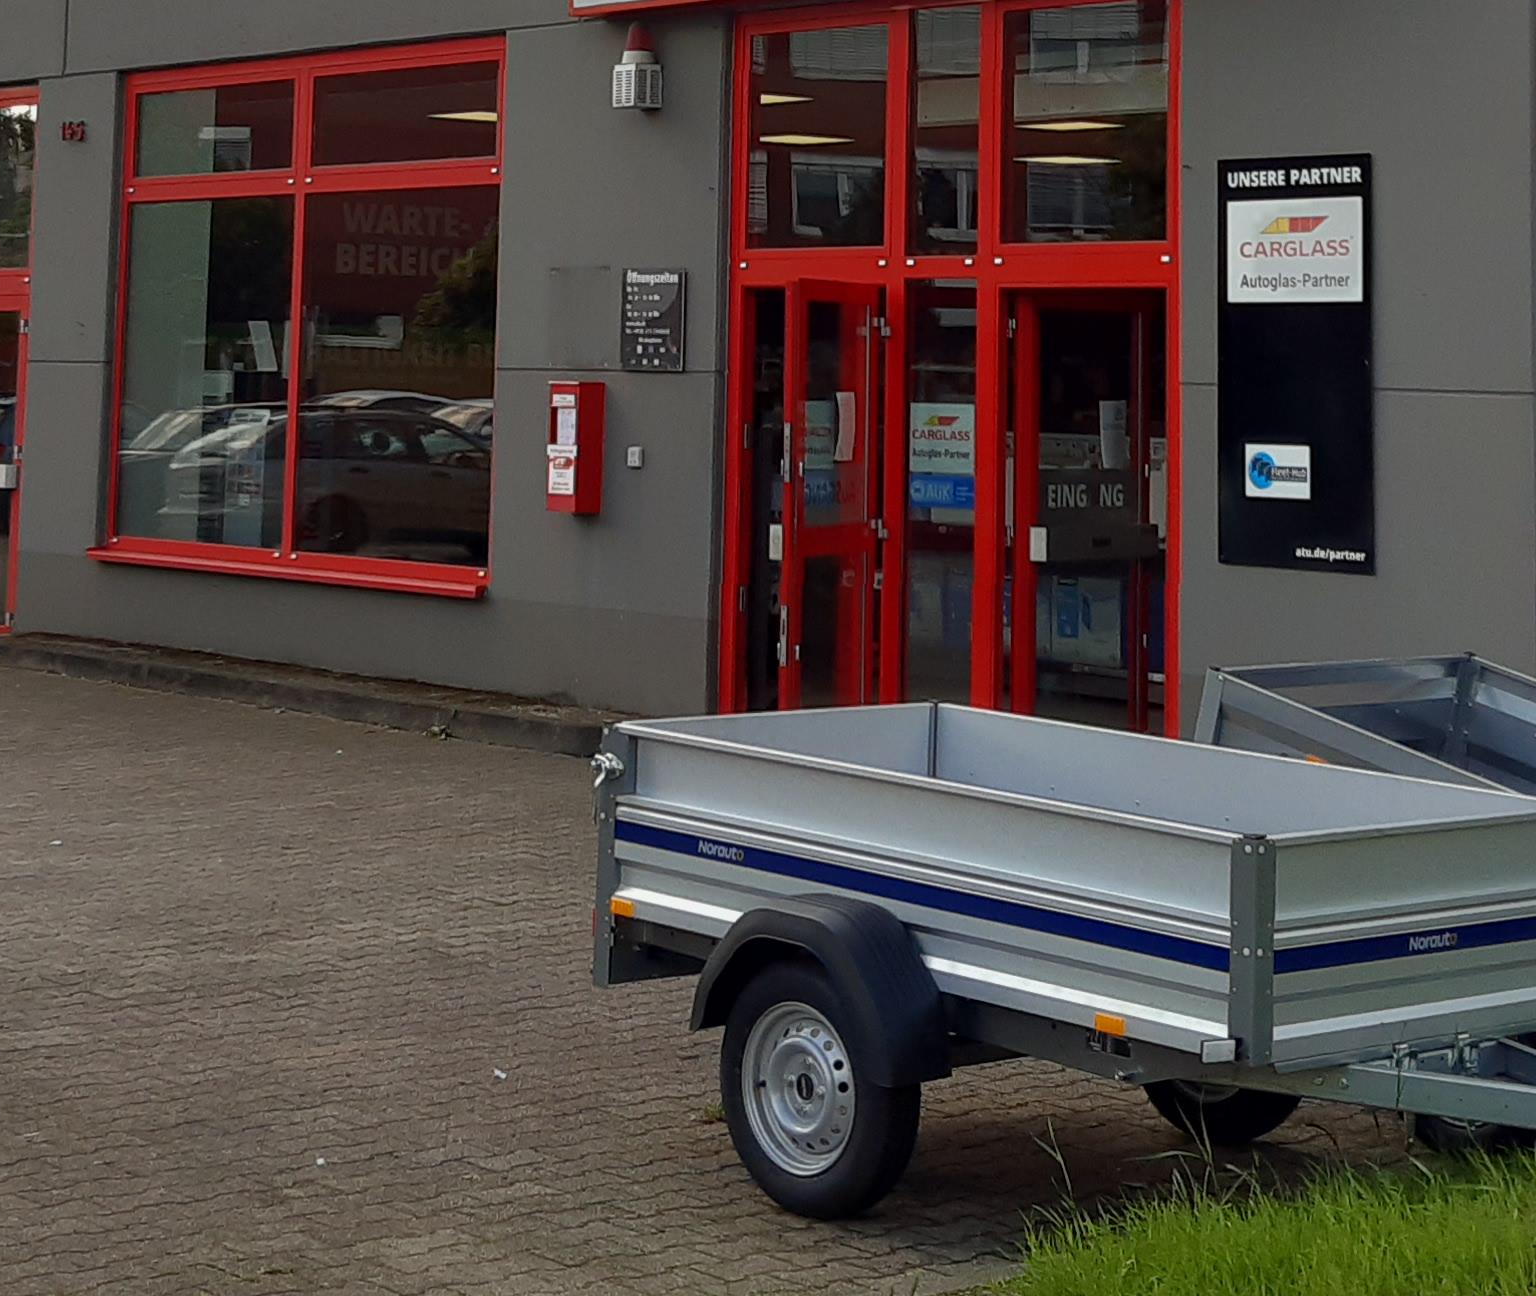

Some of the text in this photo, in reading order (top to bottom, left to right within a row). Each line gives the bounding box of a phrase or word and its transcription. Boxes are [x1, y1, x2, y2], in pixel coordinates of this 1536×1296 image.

[1227, 166, 1362, 189] UNSERE PARTNER
[343, 202, 472, 237] WARTE-
[1239, 239, 1350, 259] CARGLASS
[1240, 272, 1351, 292] Autoglas-Partner
[911, 428, 971, 442] CARGLASS
[1047, 483, 1125, 508] EINGNG
[1295, 547, 1366, 563] atu.de/partner
[697, 839, 745, 862] Norauto
[1408, 931, 1458, 952] Norauto
